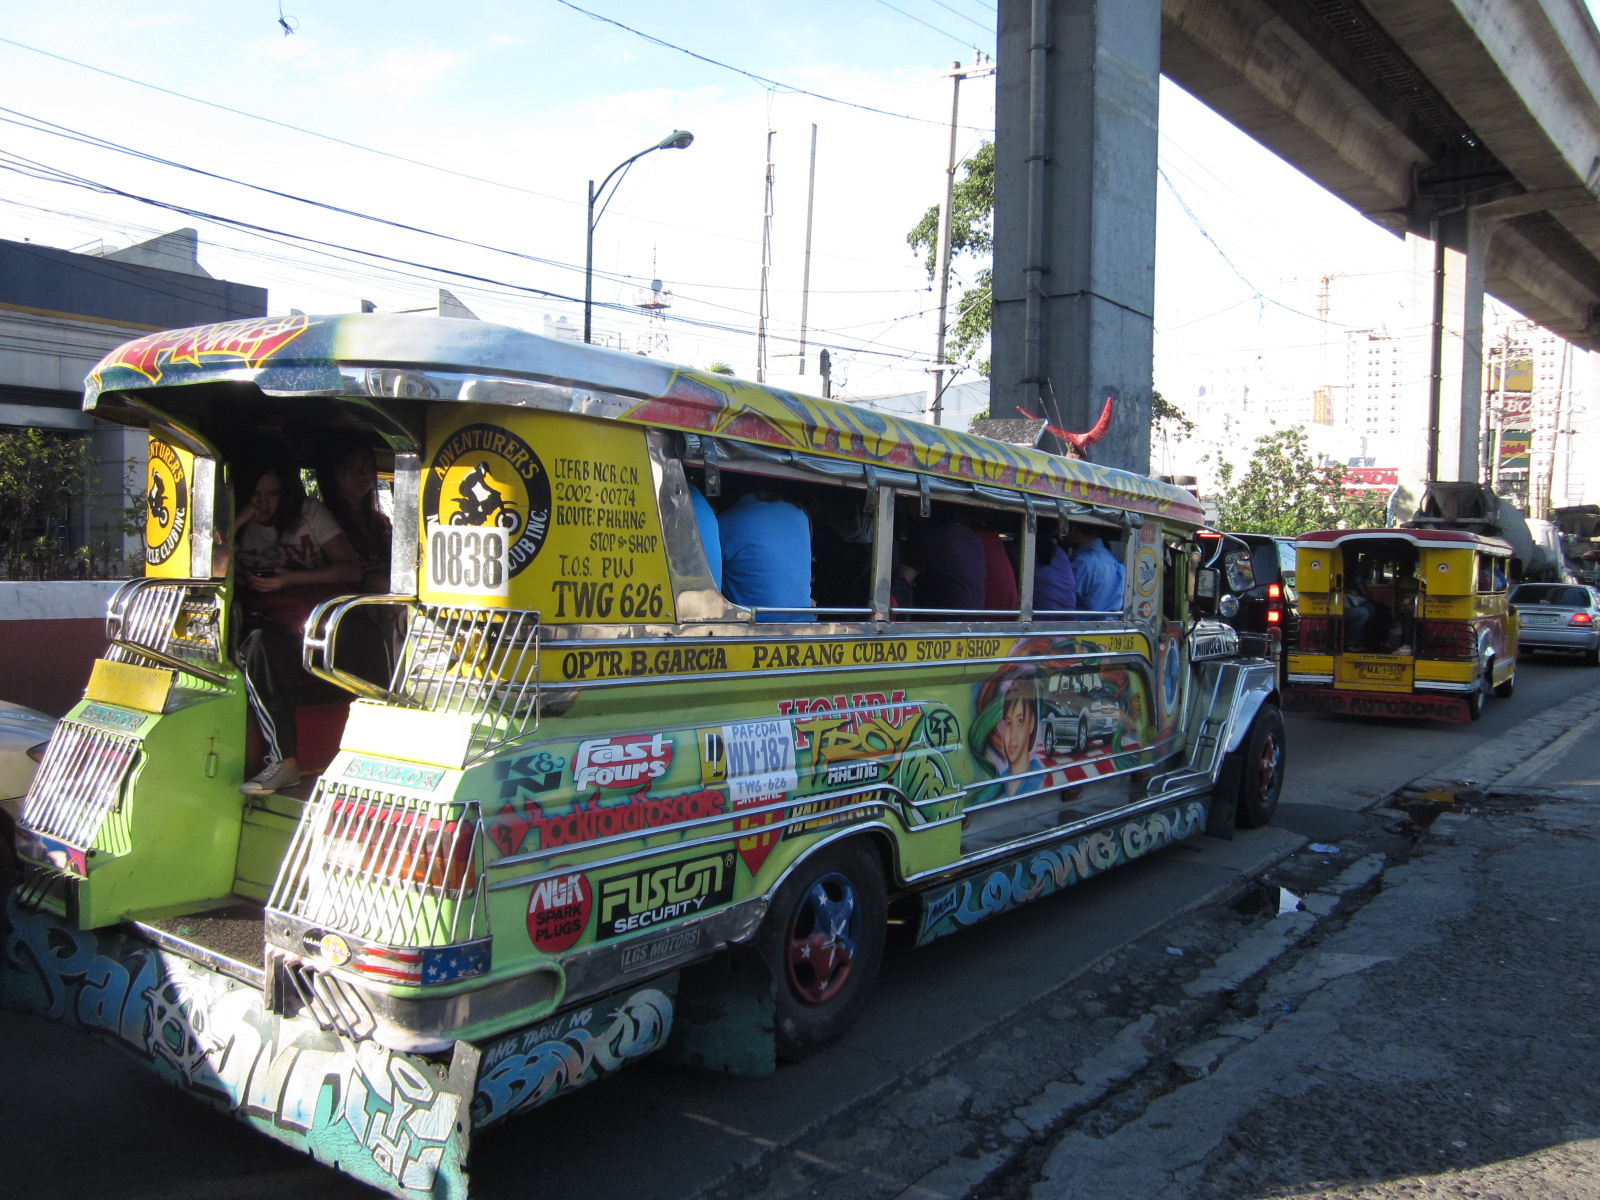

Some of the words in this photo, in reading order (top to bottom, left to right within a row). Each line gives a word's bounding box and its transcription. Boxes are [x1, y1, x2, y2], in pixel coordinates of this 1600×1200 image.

[434, 430, 540, 481] ADVENTURER'S
[555, 458, 590, 481] LTFRB
[593, 461, 618, 485] NCR
[620, 466, 640, 486] C.N.
[507, 539, 536, 572] LUB
[590, 531, 616, 552] STOP
[628, 534, 658, 554] SHOP
[432, 530, 503, 590] 0838
[559, 554, 593, 578] T.O.S.
[601, 557, 635, 579] PUJ
[551, 580, 614, 619] TWG
[619, 583, 664, 618] 626
[752, 643, 845, 669] PARANG
[852, 641, 908, 664] CUBAO
[916, 640, 952, 661] STOP
[956, 641, 964, 658] &
[967, 638, 1001, 658] SHOP
[827, 761, 880, 786] RACING
[528, 873, 585, 914] NGK
[535, 903, 583, 926] SPARK
[613, 895, 707, 934] SECURITY
[535, 919, 582, 943] PLUGS
[649, 929, 697, 959] MOTORS
[484, 1038, 518, 1073] ANG
[569, 1007, 594, 1028] NG
